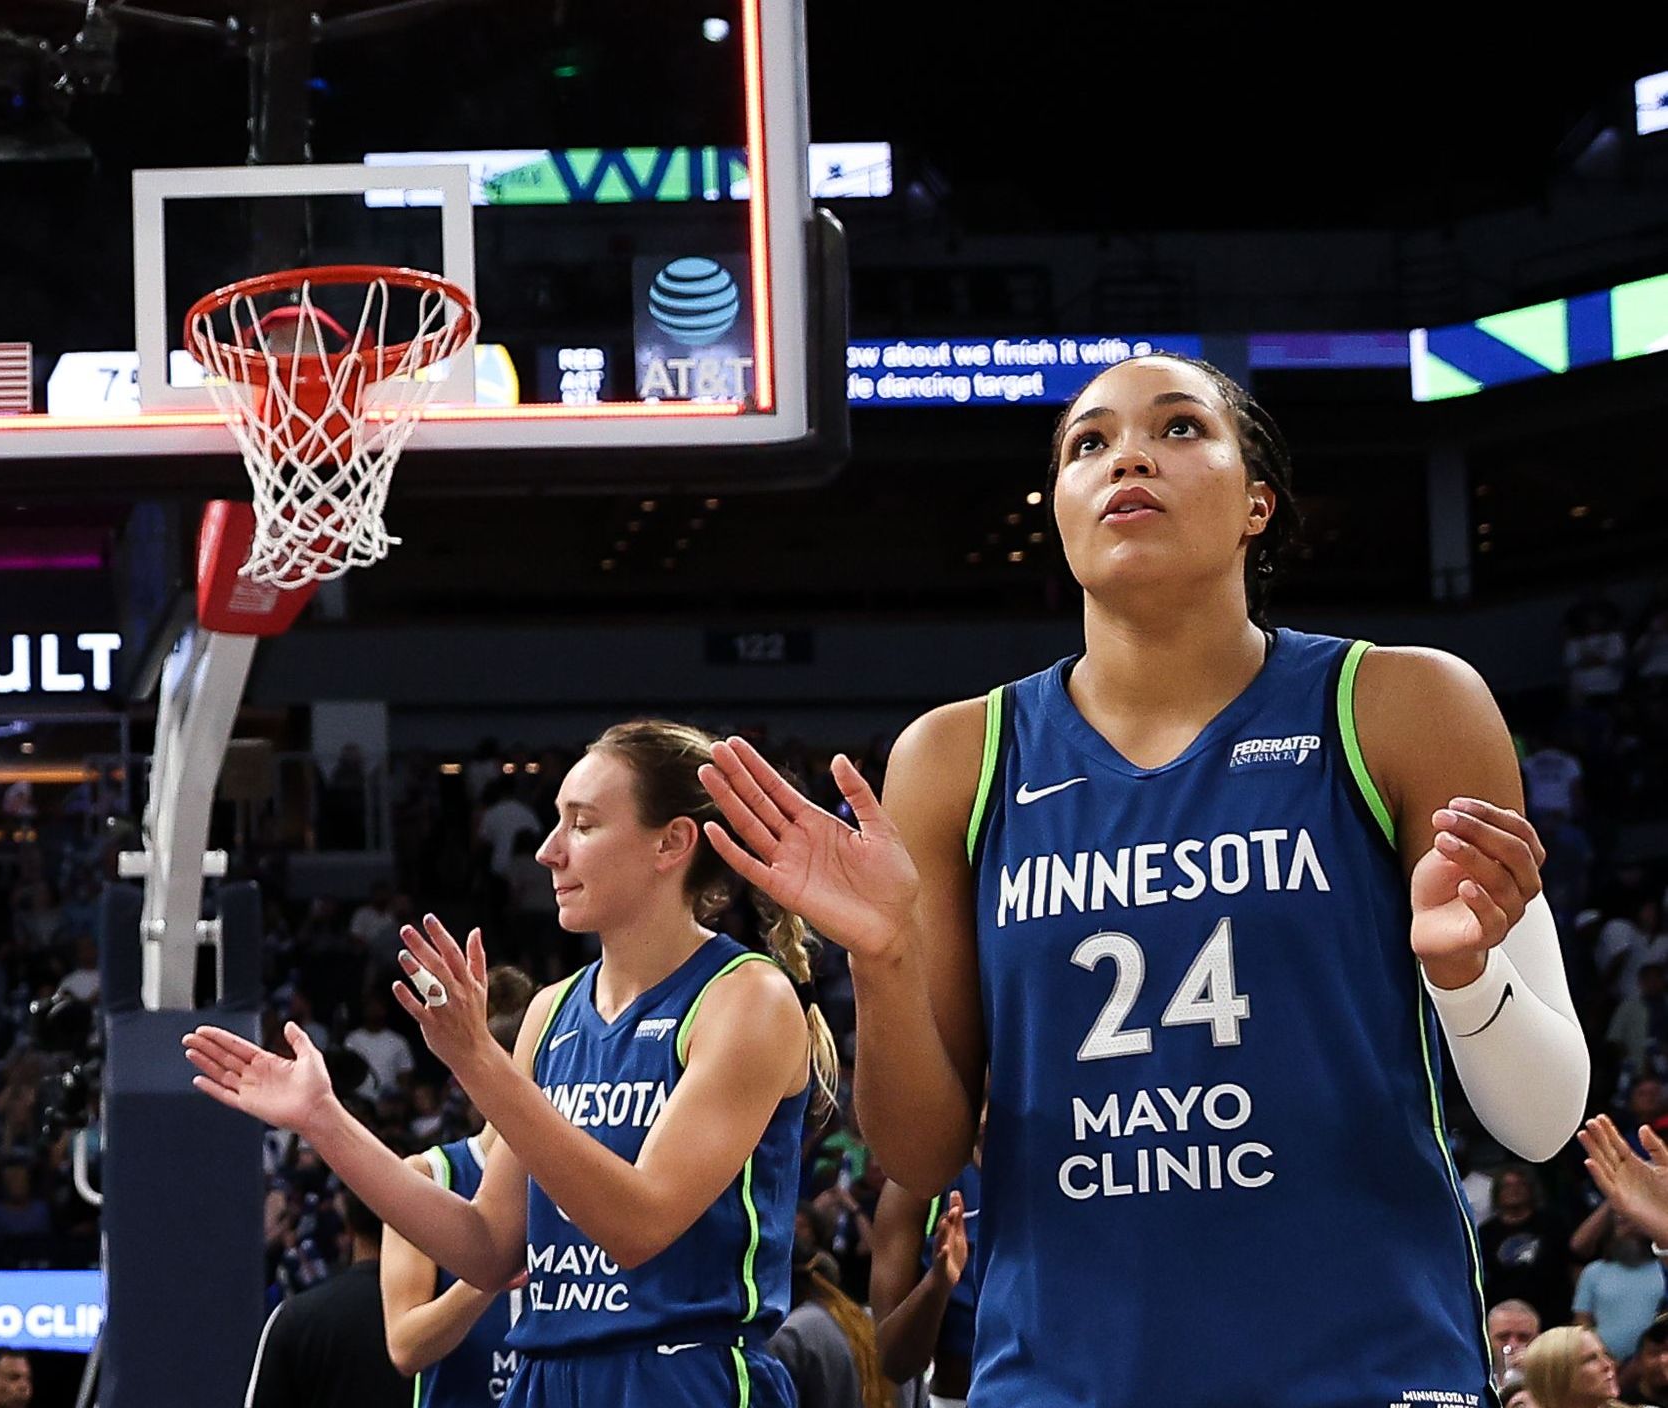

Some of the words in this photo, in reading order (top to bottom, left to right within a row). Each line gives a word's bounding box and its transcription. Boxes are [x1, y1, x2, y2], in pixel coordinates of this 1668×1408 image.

[640, 357, 754, 398] AT&T
[1232, 735, 1321, 758] FEDERATED
[996, 828, 1331, 929] MINNESOTA
[1069, 916, 1251, 1063] 24
[1072, 1083, 1252, 1141] MAYO
[1058, 1142, 1276, 1200] CLINIC
